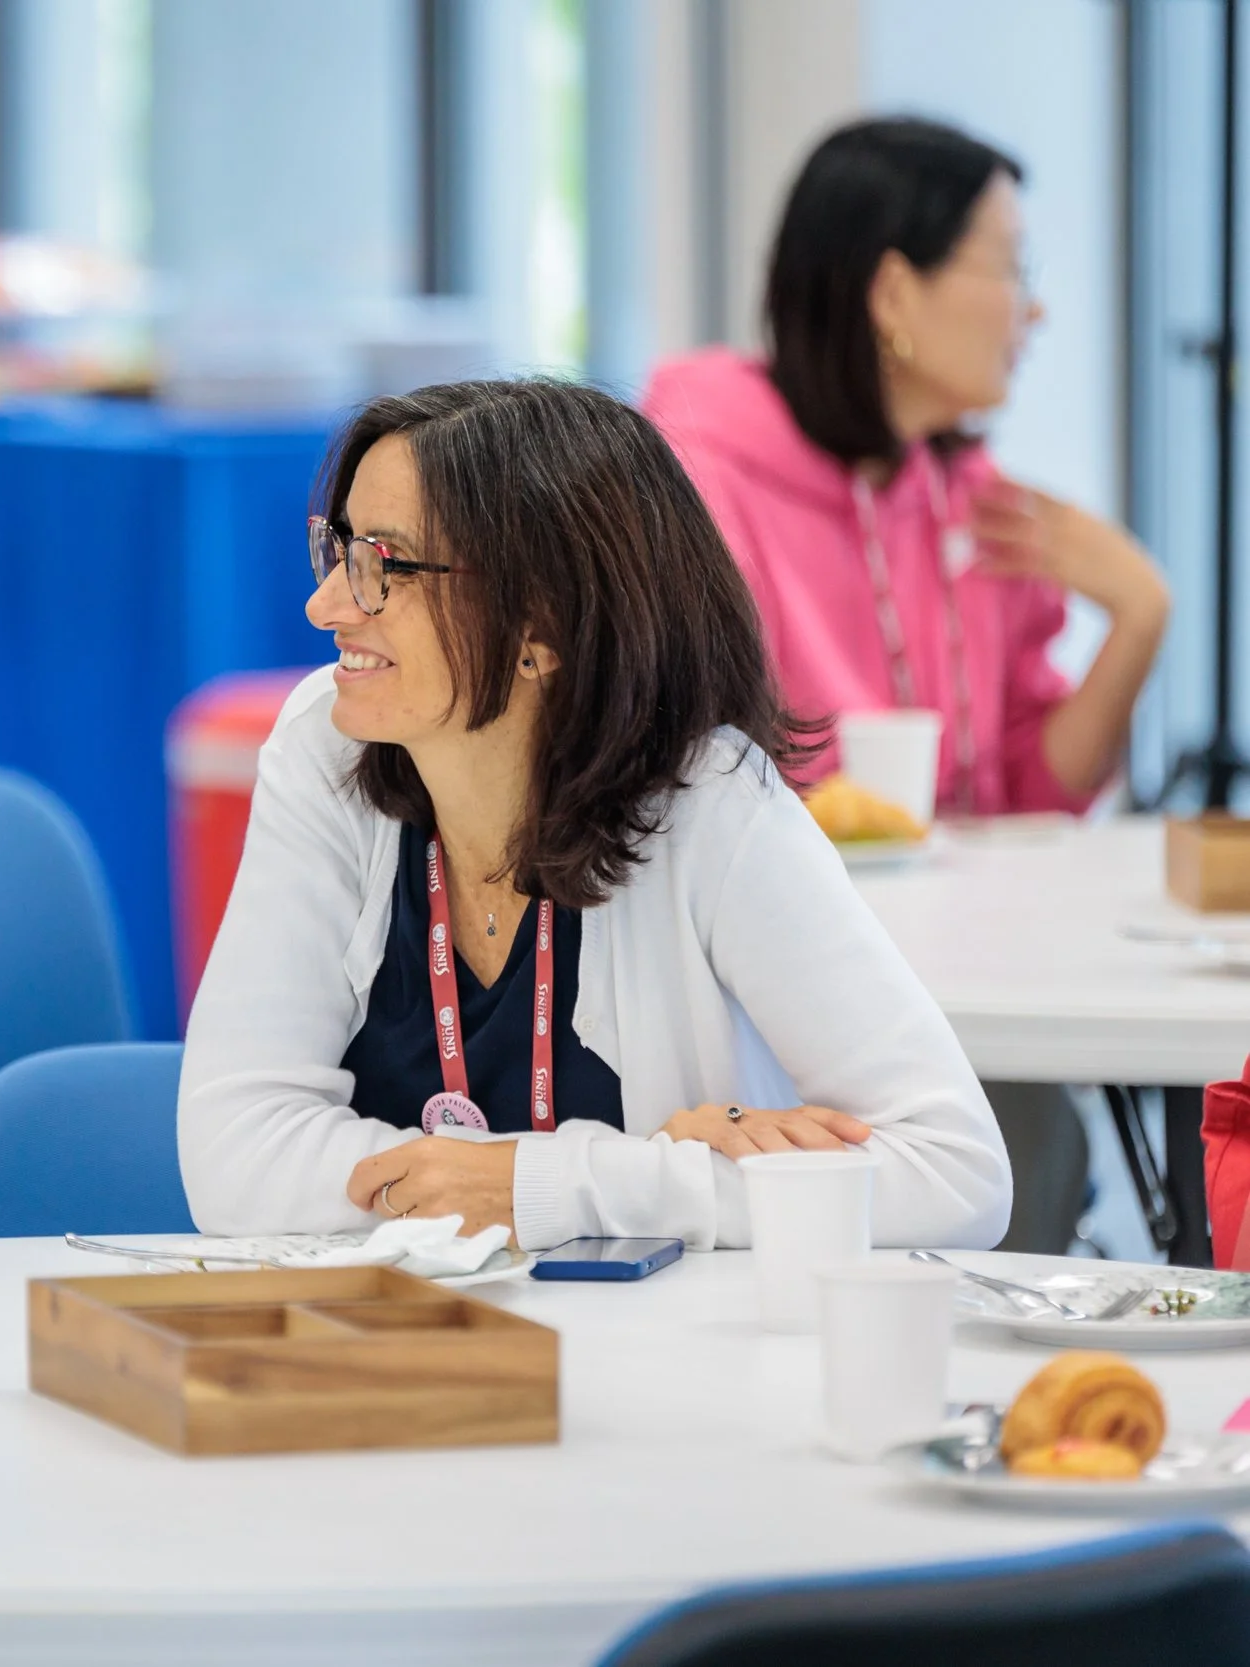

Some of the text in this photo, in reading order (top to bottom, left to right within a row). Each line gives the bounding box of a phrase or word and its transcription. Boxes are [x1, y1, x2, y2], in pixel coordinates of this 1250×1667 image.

[428, 860, 441, 893] UNIS
[540, 900, 550, 932] UNIS
[433, 941, 450, 976] UNIS
[537, 983, 548, 1016] UNIS
[442, 1026, 458, 1060] UNIS
[535, 1067, 548, 1100] UNIS
[425, 1098, 483, 1135] OTHERS FOR PALESTINE
